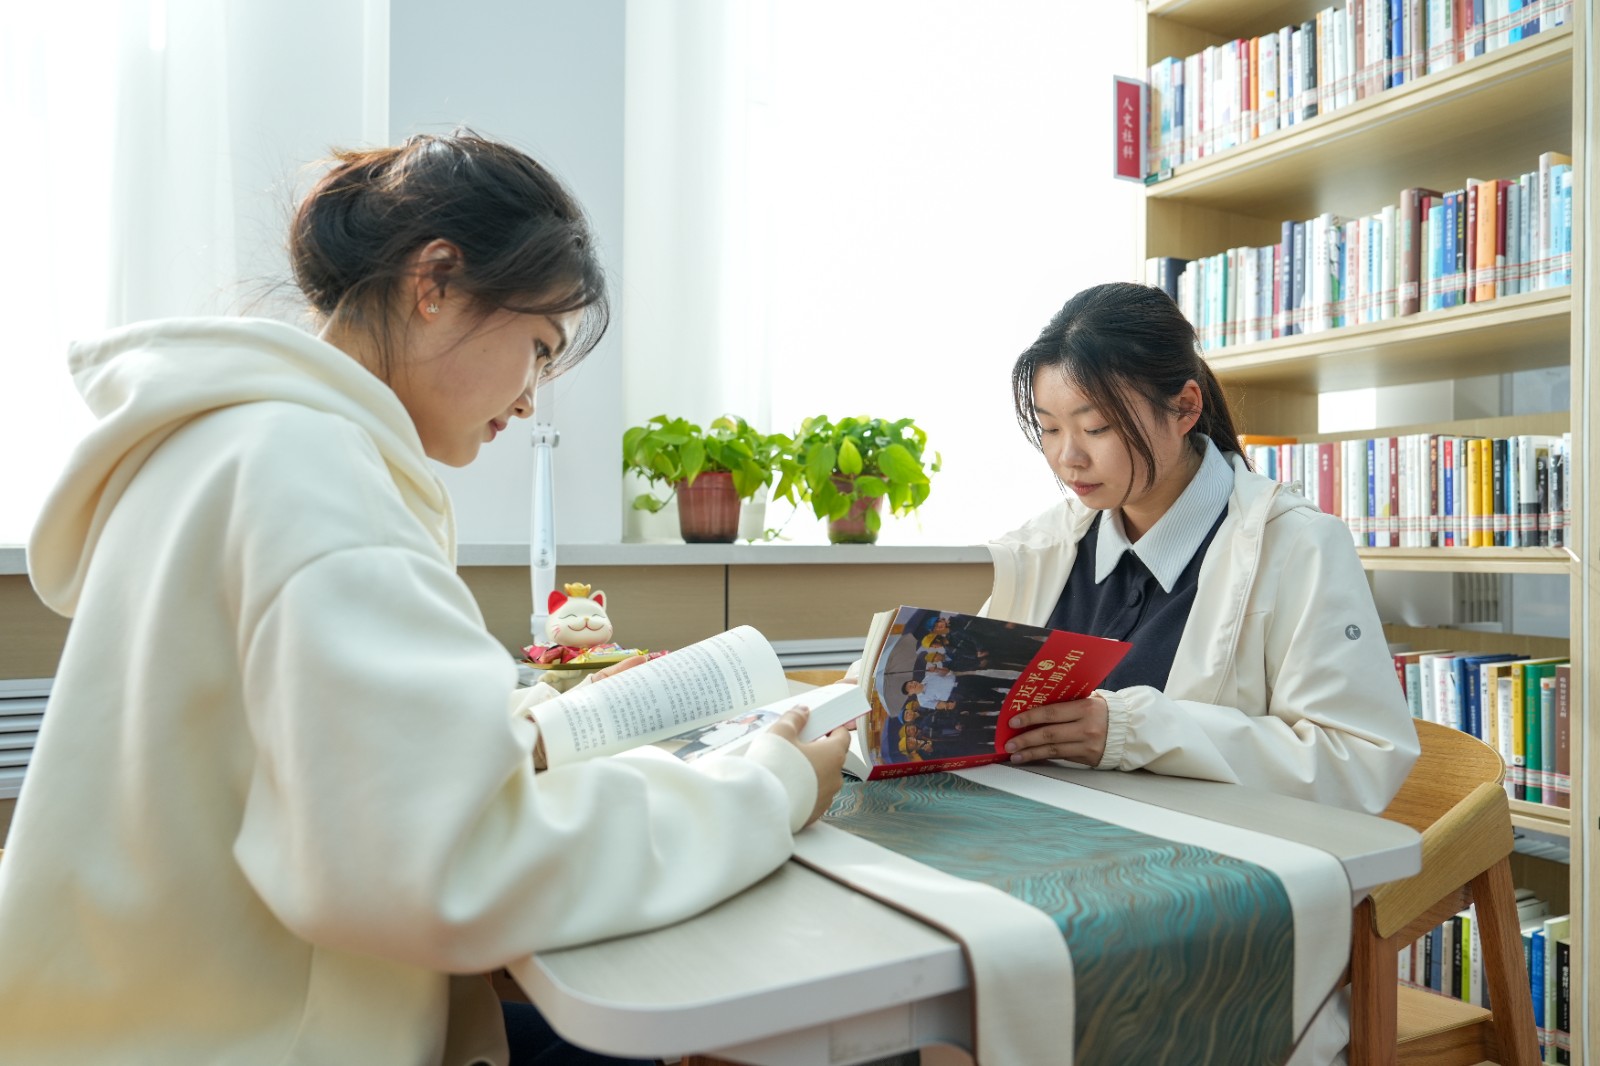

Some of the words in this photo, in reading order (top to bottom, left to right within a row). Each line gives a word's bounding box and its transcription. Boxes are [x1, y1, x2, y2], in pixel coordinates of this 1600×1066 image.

[1122, 97, 1134, 159] 人文社科
[1009, 659, 1056, 711] 习近平与
